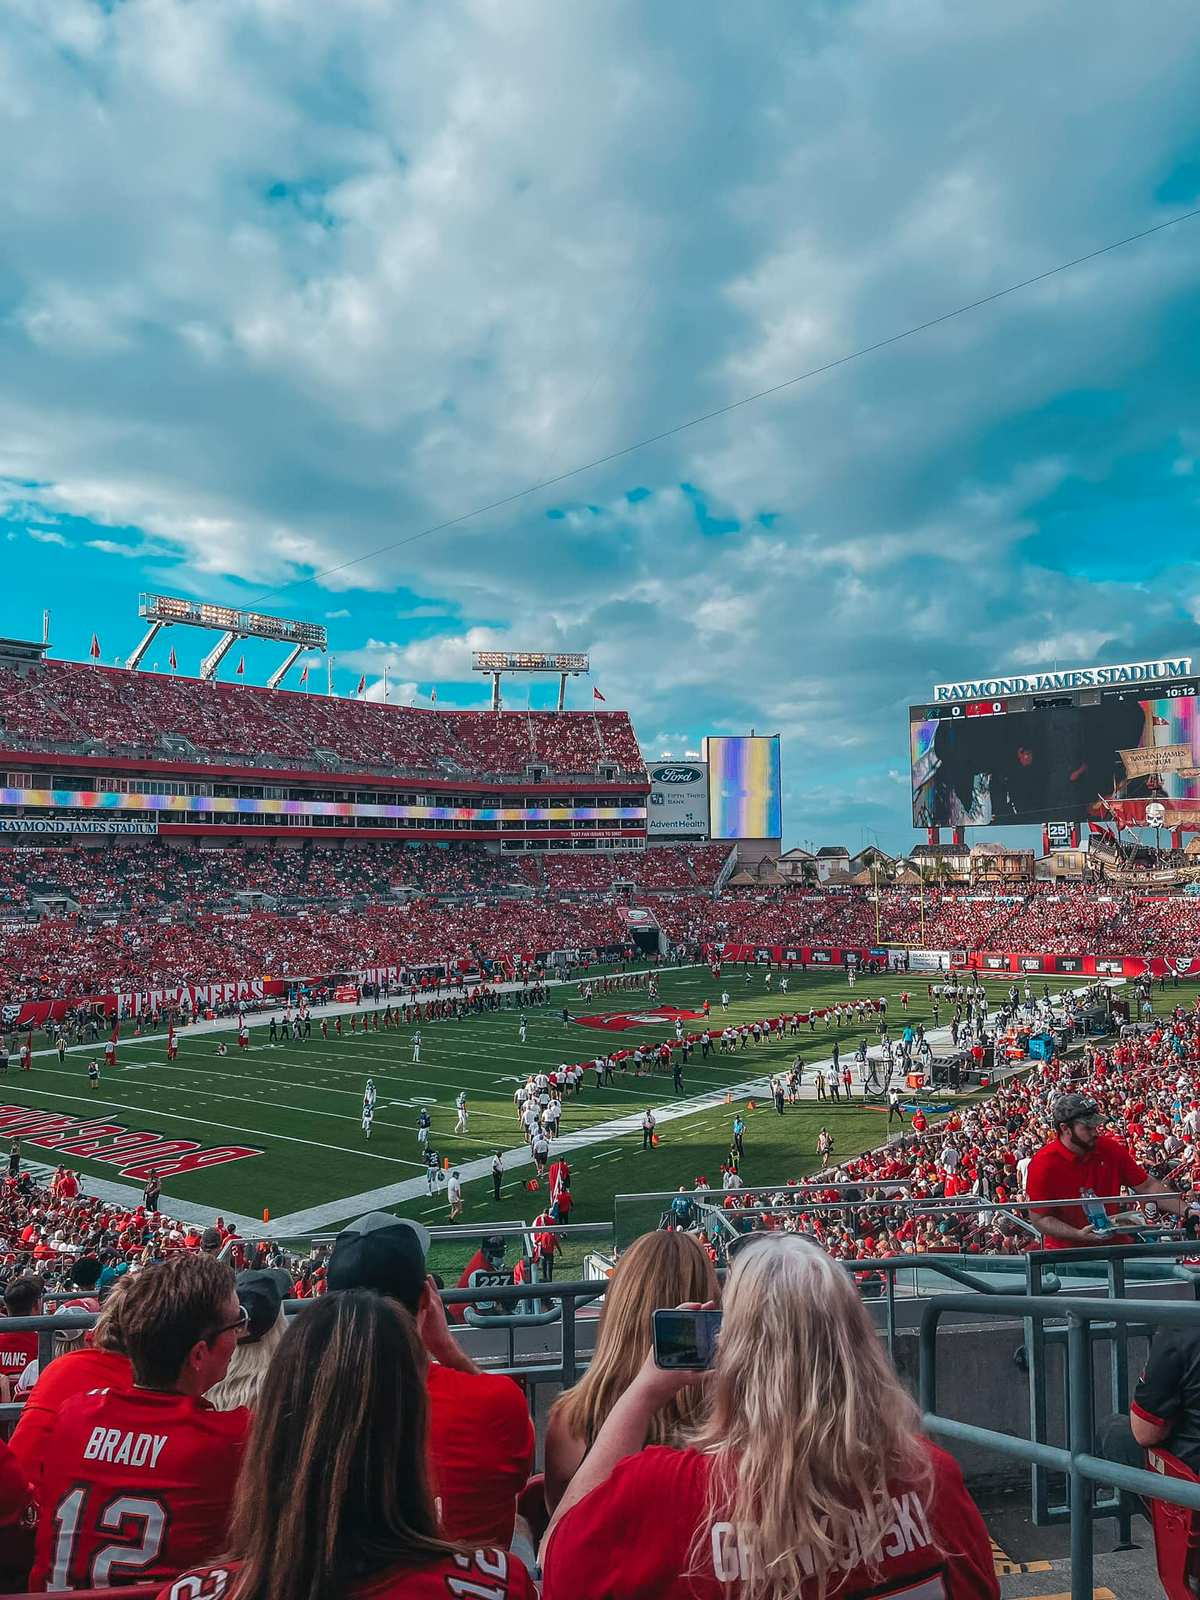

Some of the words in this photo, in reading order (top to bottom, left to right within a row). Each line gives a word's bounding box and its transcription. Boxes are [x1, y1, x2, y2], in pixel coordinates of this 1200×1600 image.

[937, 679, 1029, 700] RAYMOND
[1029, 671, 1094, 691] JAMES
[1096, 660, 1191, 685] STADIUM
[1165, 688, 1195, 697] 10:12
[951, 706, 960, 716] 0
[992, 702, 1001, 712] 0
[661, 768, 693, 781] Ford
[0, 821, 65, 833] RAYMOND
[66, 822, 106, 833] JAMES
[108, 823, 157, 834] STADIUM
[650, 820, 705, 828] AdventHealth
[1050, 826, 1066, 836] 25
[480, 1275, 511, 1288] 227
[0, 1352, 28, 1366] VANS
[84, 1427, 168, 1468] BRADY
[47, 1490, 166, 1592] 12
